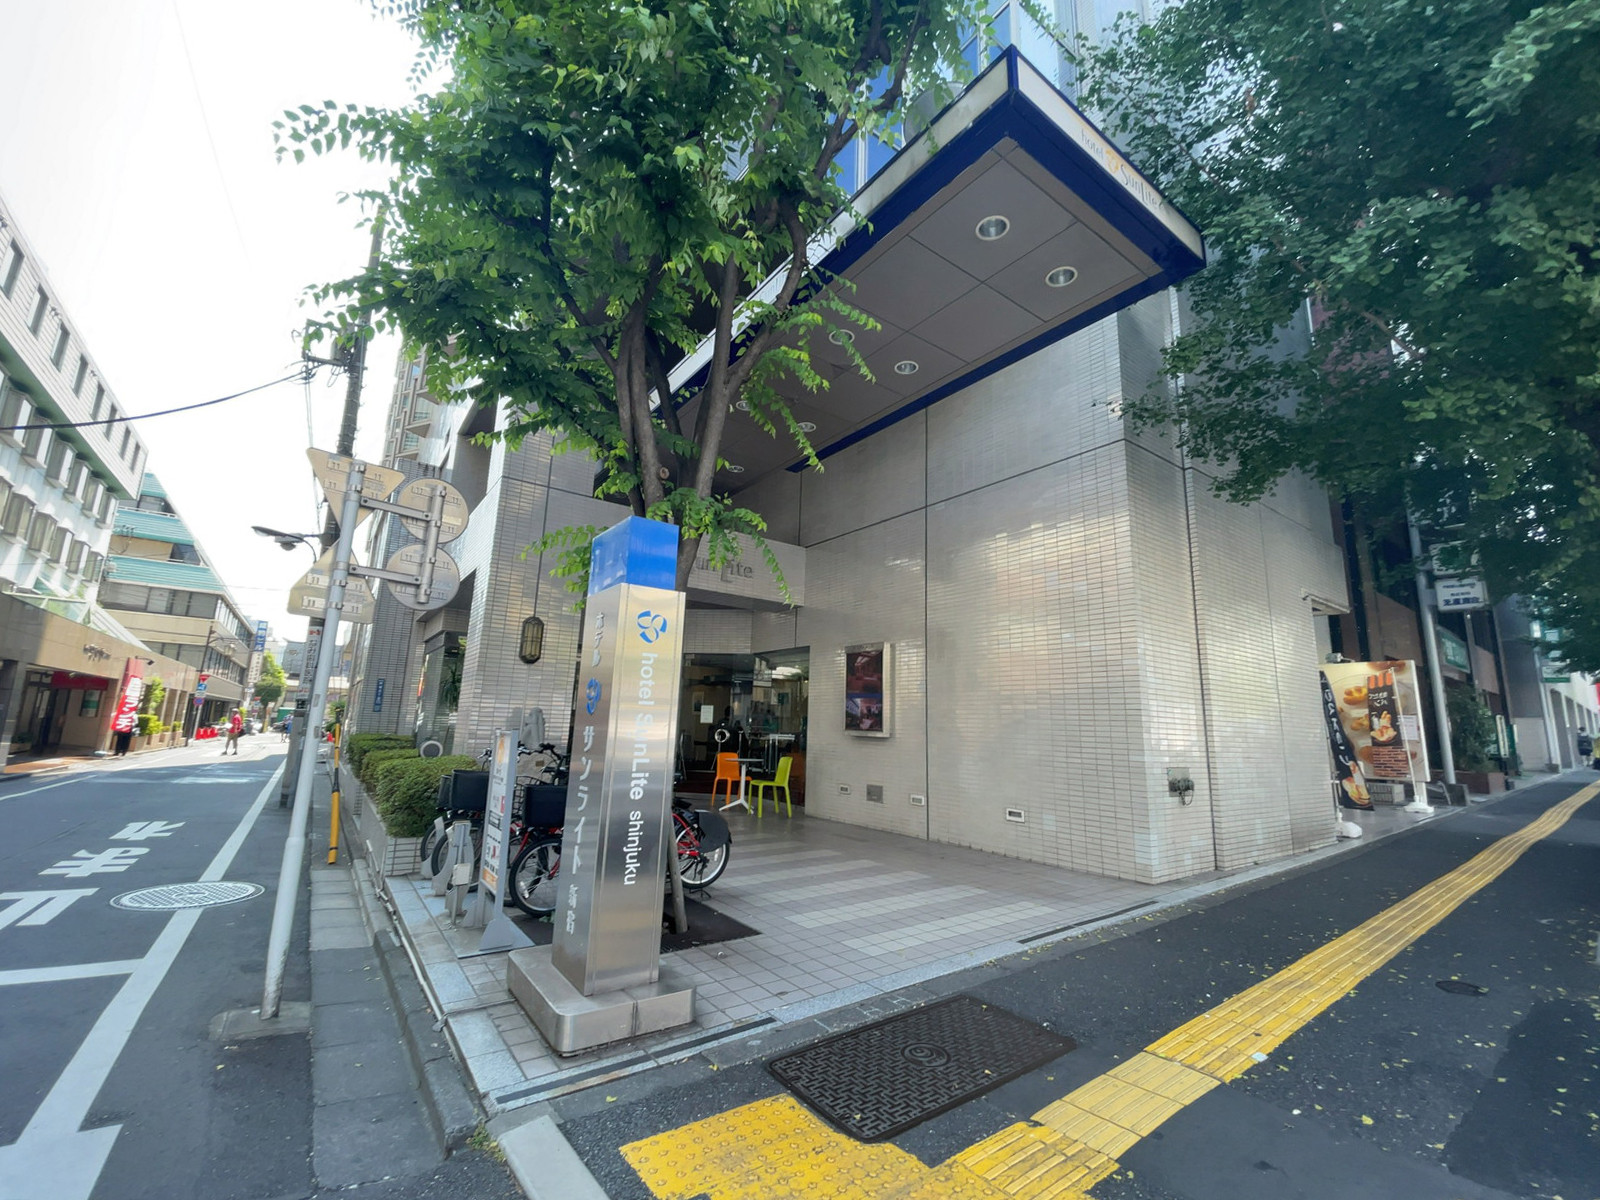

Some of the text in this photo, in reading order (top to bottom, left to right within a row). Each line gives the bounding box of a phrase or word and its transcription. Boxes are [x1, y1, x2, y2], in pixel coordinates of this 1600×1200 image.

[592, 612, 605, 667] ホテル
[572, 725, 595, 874] サンライト
[622, 652, 658, 886] hotel SunLite shinjuku
[0, 821, 186, 931] 止まれ
